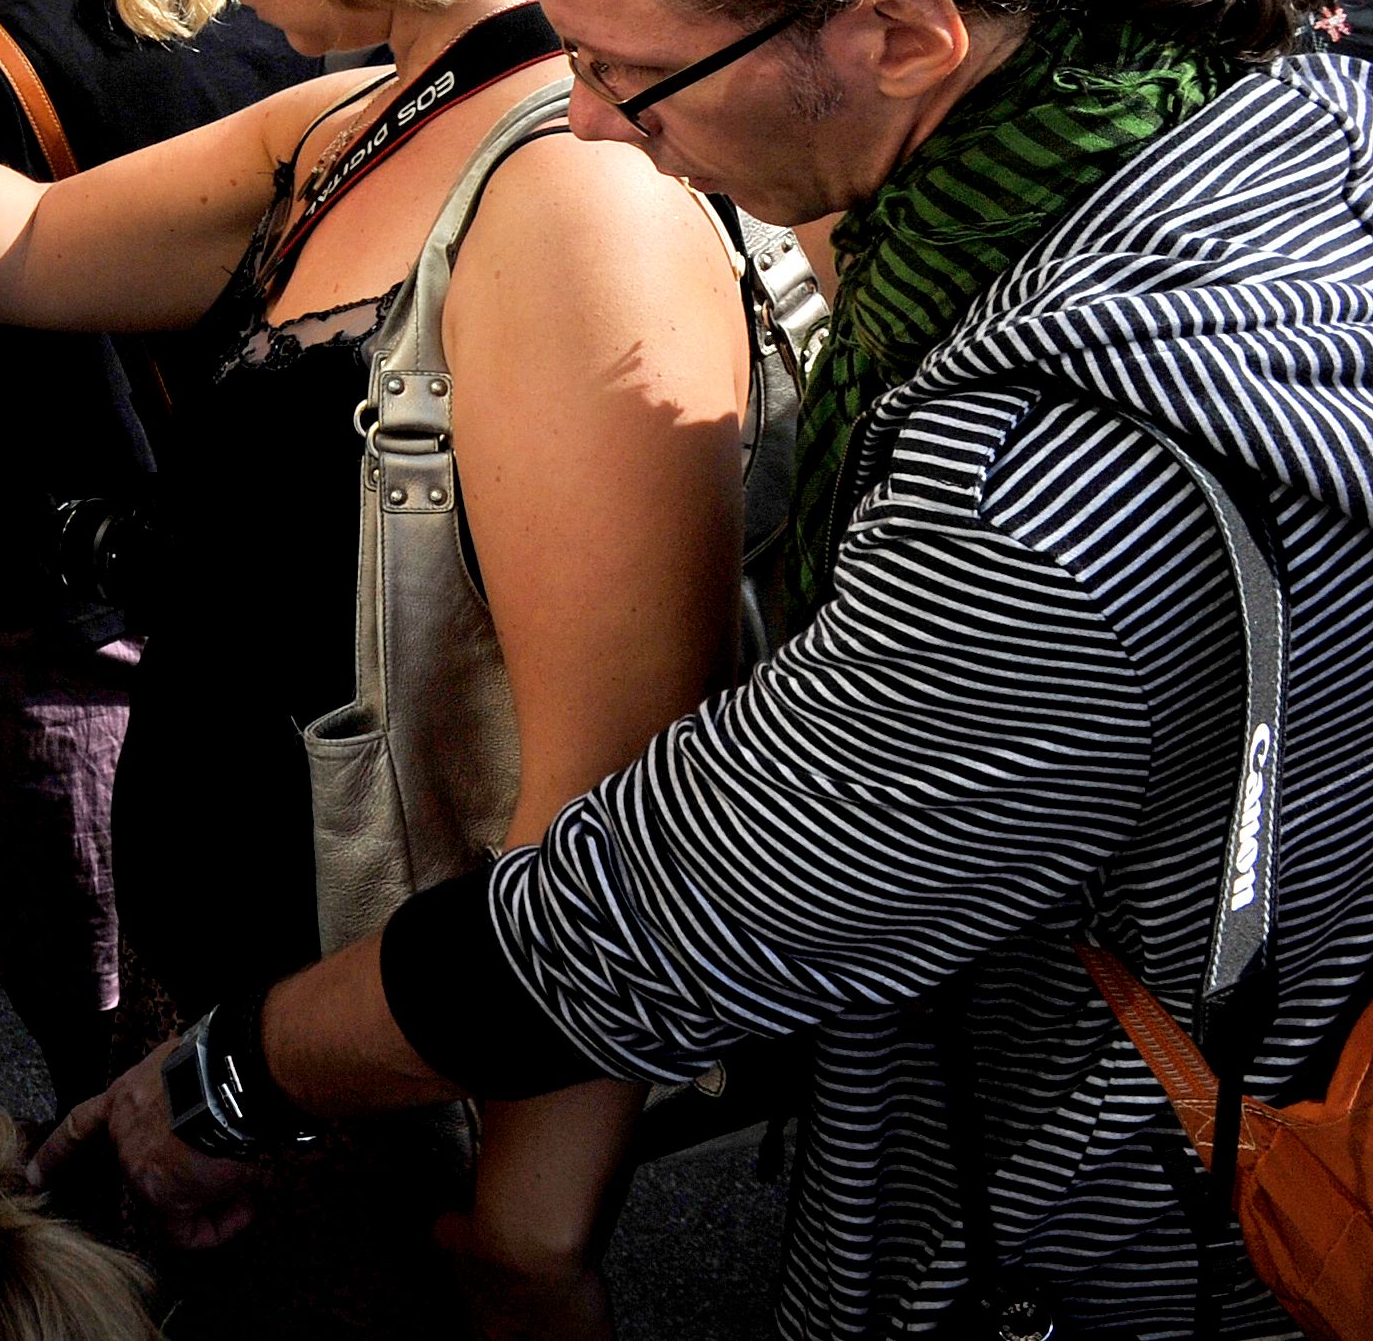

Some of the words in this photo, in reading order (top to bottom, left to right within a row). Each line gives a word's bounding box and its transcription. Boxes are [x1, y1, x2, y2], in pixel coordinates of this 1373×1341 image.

[397, 70, 455, 127] EOS
[306, 122, 389, 216] DIGITAL
[1231, 722, 1270, 912] Canon
